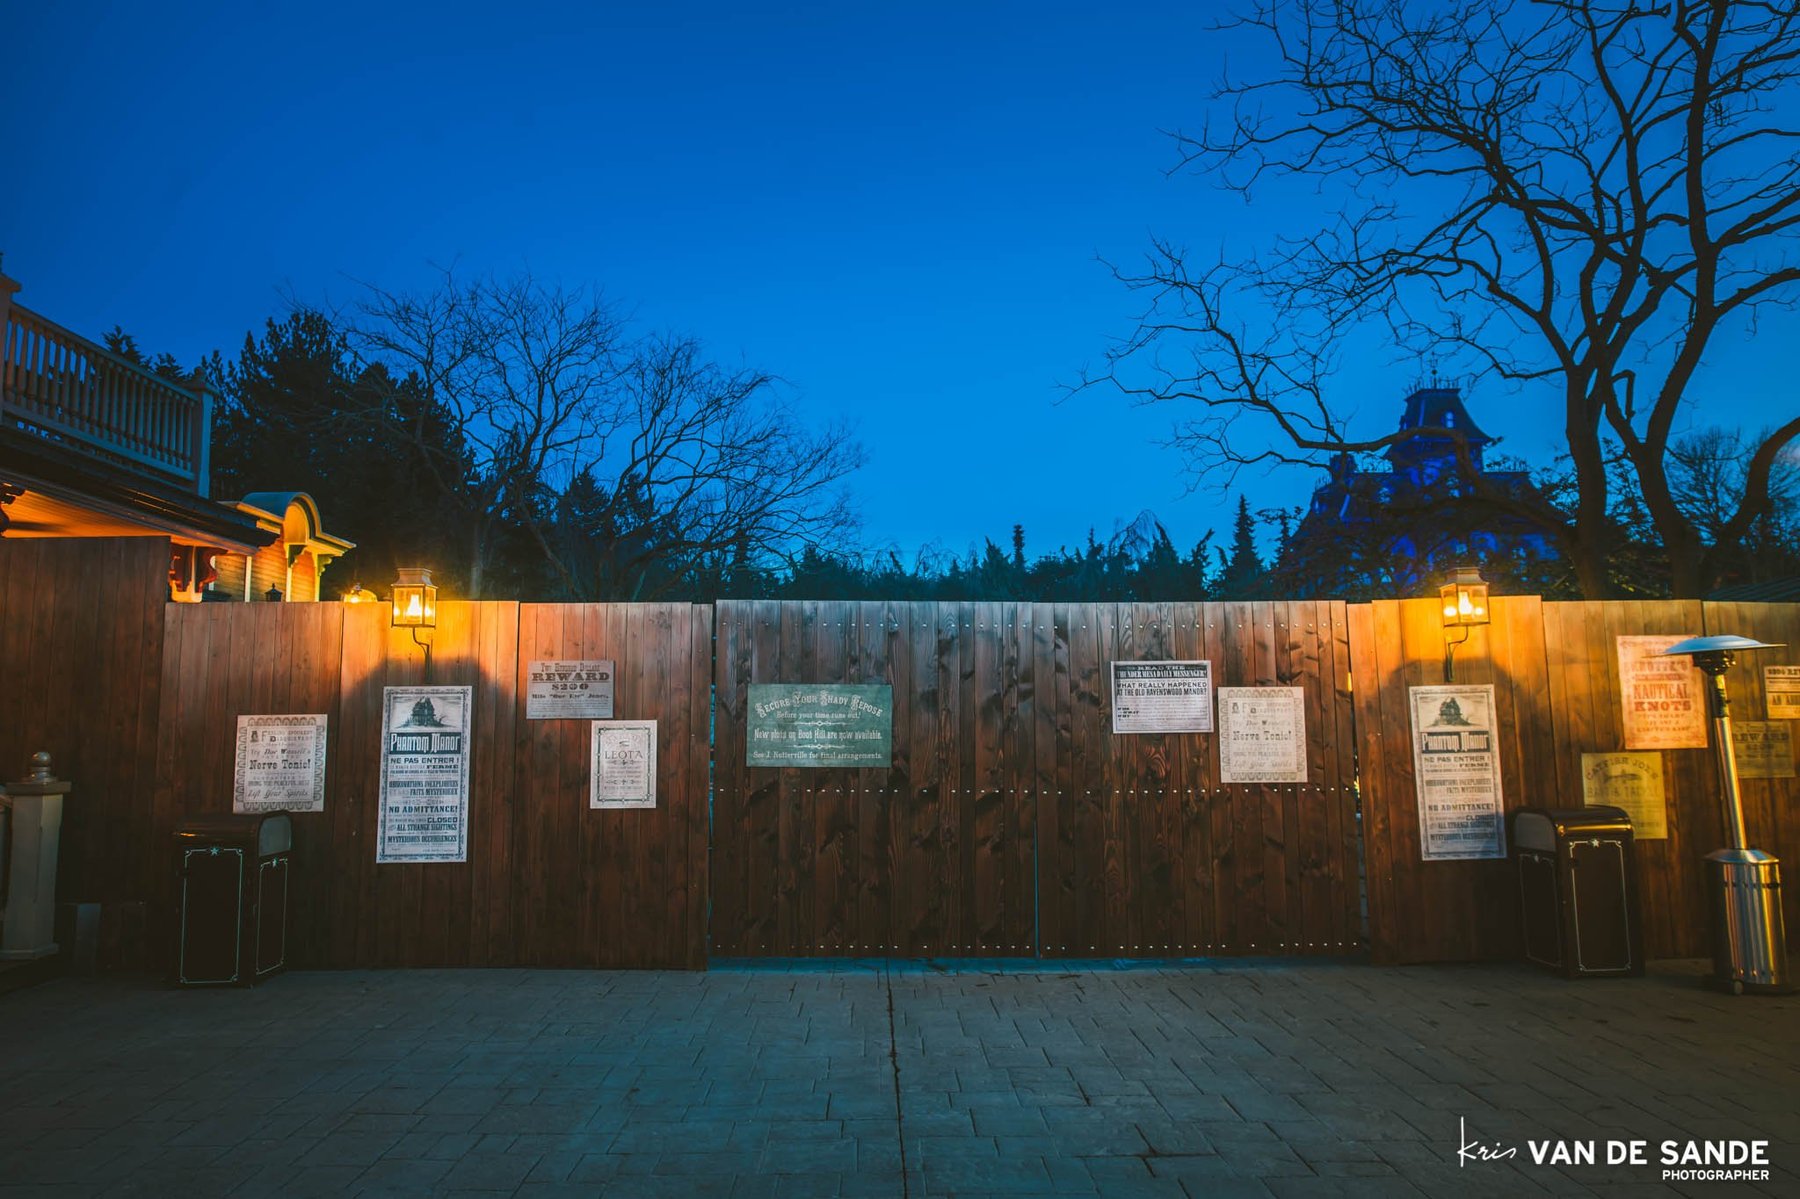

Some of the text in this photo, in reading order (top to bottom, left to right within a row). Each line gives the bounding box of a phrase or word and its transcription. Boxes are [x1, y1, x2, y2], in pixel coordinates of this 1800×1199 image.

[532, 672, 609, 681] REWARD
[1124, 689, 1134, 697] THE
[1135, 689, 1145, 697] OLD
[1633, 683, 1690, 699] NAUTICAL
[755, 689, 883, 718] SECURE YOUR SHADY REPOSE
[1634, 701, 1691, 711] KNOTS
[799, 712, 813, 720] your
[604, 750, 643, 760] LEOTA
[809, 751, 818, 759] for
[249, 759, 311, 769] Nerve Tonic!
[402, 805, 458, 813] ADMITTANCE!
